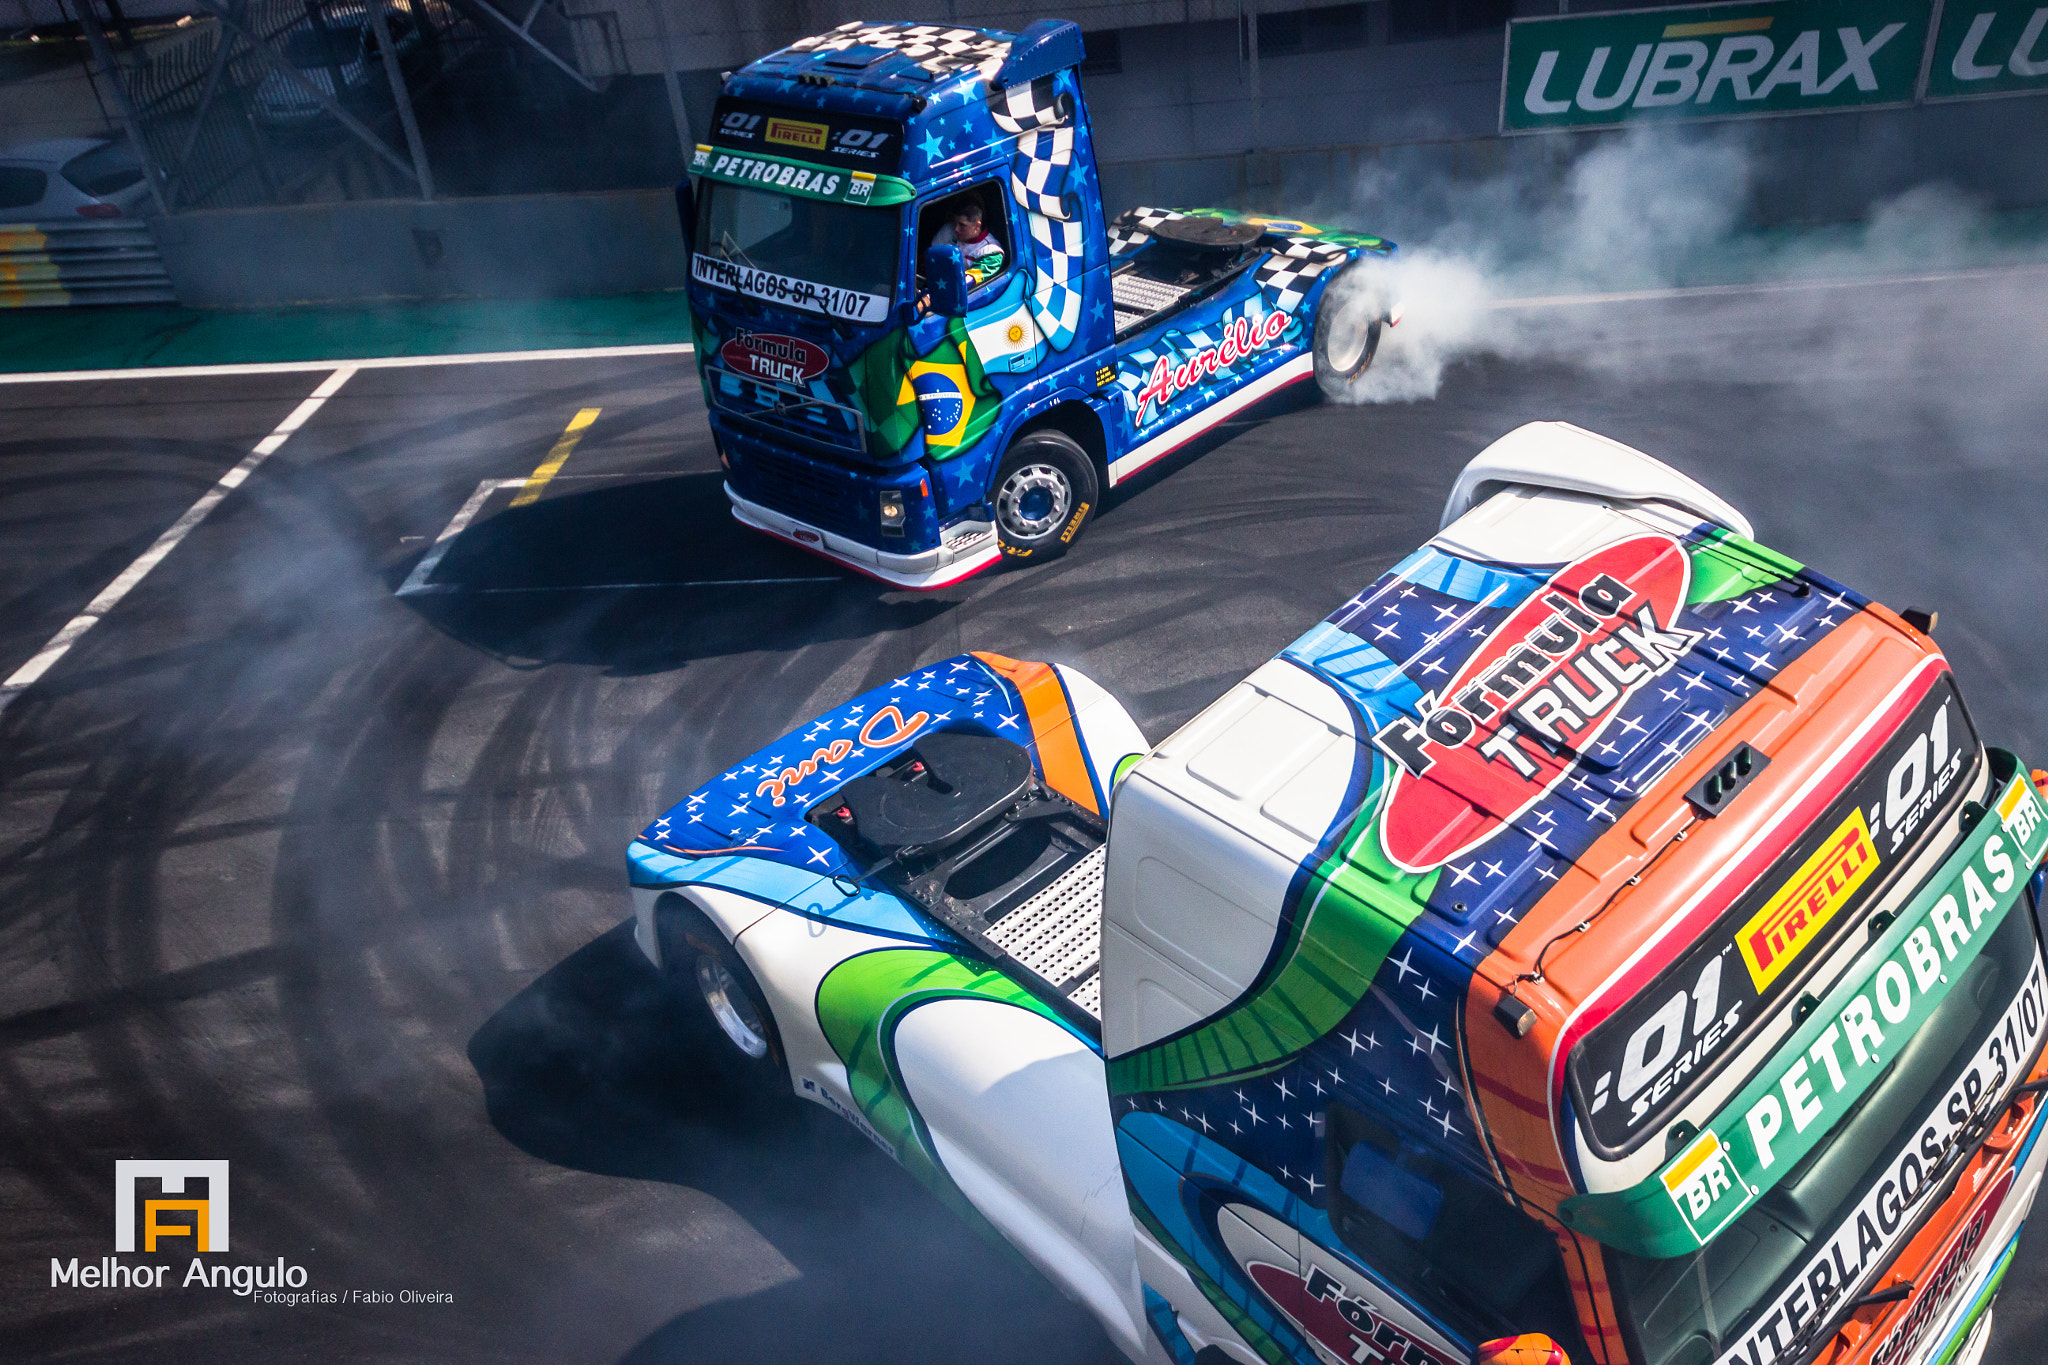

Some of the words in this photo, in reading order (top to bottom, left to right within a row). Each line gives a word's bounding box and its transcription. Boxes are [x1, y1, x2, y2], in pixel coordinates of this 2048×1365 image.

[1523, 22, 1908, 115] LUBRAX
[718, 127, 756, 140] SERIES
[771, 122, 823, 146] PIRELLI
[831, 145, 880, 159] SERIES
[711, 155, 841, 195] PETROBRAS
[849, 181, 872, 197] BR
[820, 287, 871, 317] 31/07
[735, 327, 807, 364] Fórmula
[749, 354, 806, 388] TRUCK
[1135, 310, 1292, 427] Aurélio
[1372, 572, 1637, 780] Fórmula
[1476, 601, 1700, 782] TRUCK
[756, 705, 930, 808] Dani
[1890, 747, 1962, 855] SERIES
[2013, 798, 2042, 847] BR
[1749, 827, 1869, 973] PIRELLI
[1745, 834, 2016, 1171] PETROBRAS
[1988, 964, 2046, 1090] 31/07
[1627, 1000, 1743, 1127] SERIES
[1685, 1161, 1732, 1221] BR
